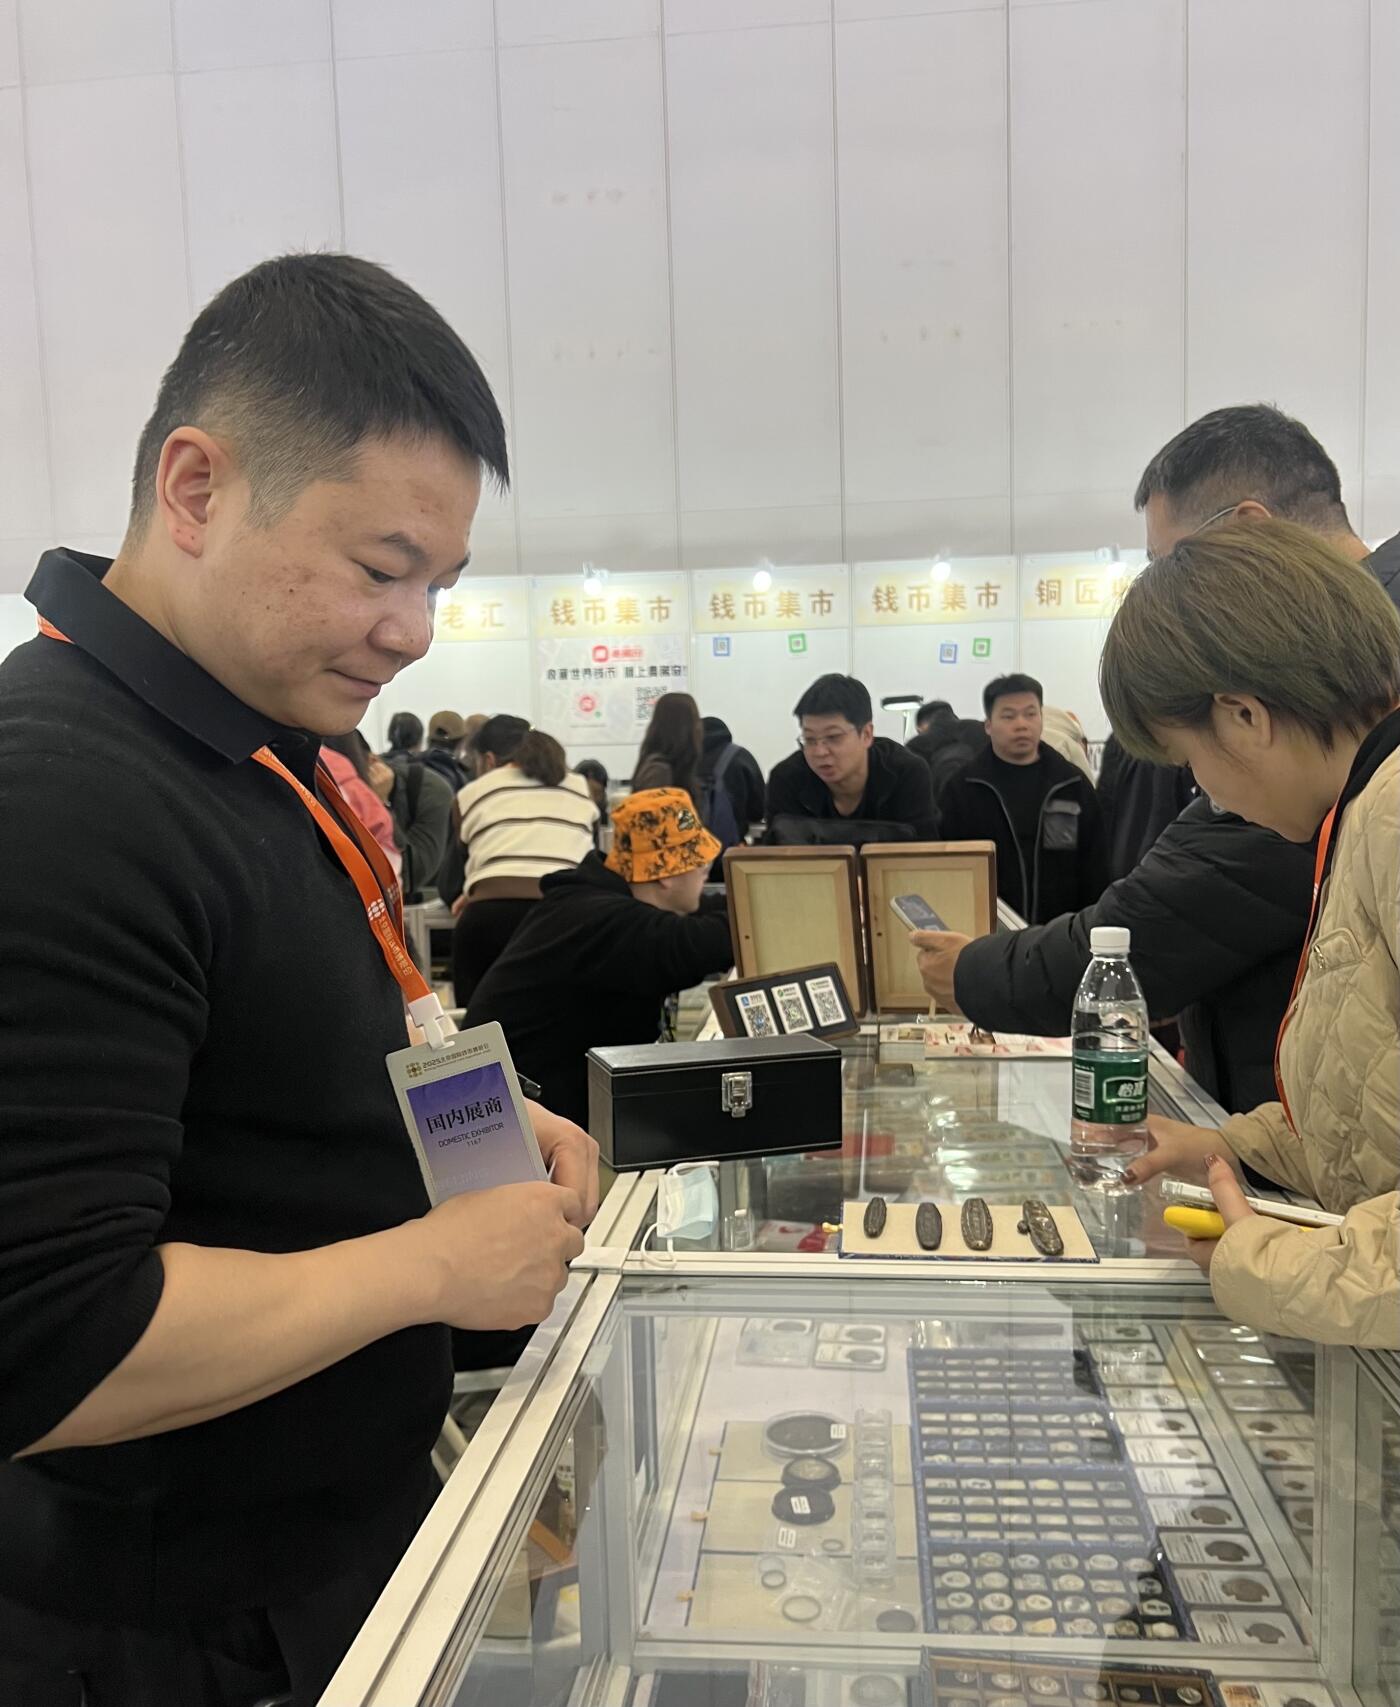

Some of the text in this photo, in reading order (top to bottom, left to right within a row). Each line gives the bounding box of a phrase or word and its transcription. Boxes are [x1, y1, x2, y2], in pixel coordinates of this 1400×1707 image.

[550, 596, 672, 626] 钱币集市
[709, 588, 834, 620] 钱币集市
[872, 581, 1001, 613] 钱币集市
[425, 1096, 503, 1134] 国内展商
[438, 1122, 504, 1148] DOMESTIC EXHIBITOR
